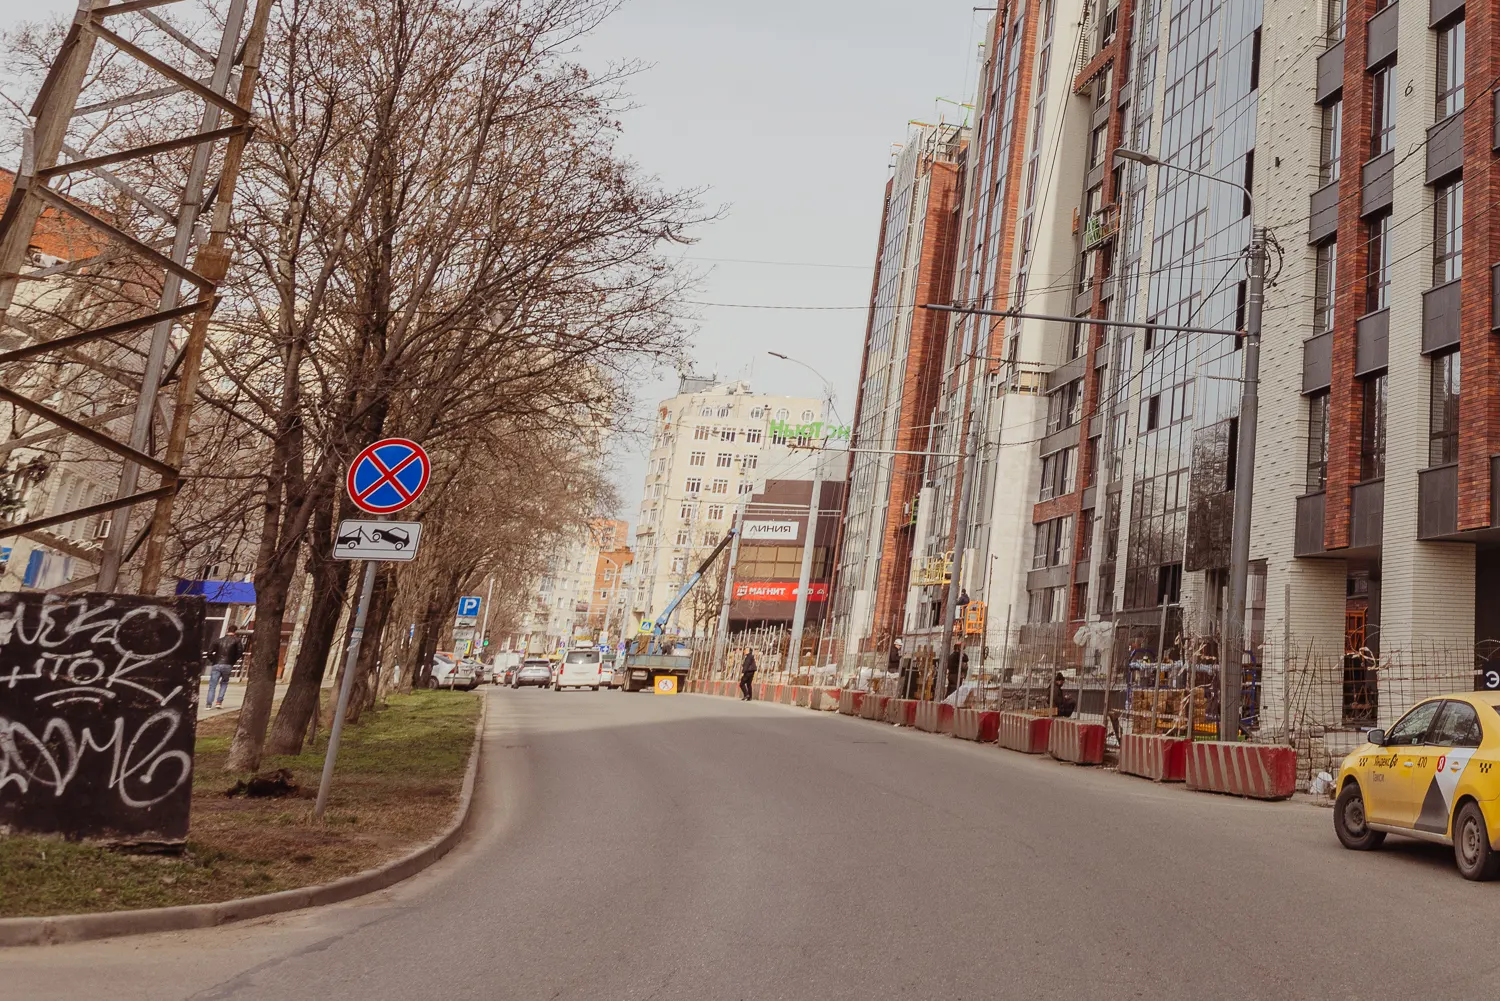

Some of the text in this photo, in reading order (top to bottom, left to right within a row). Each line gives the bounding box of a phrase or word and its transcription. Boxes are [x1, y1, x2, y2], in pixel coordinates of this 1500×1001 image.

[750, 525, 791, 533] ЛИНИЯ
[749, 587, 786, 595] МАГНИТ
[463, 599, 477, 614] P
